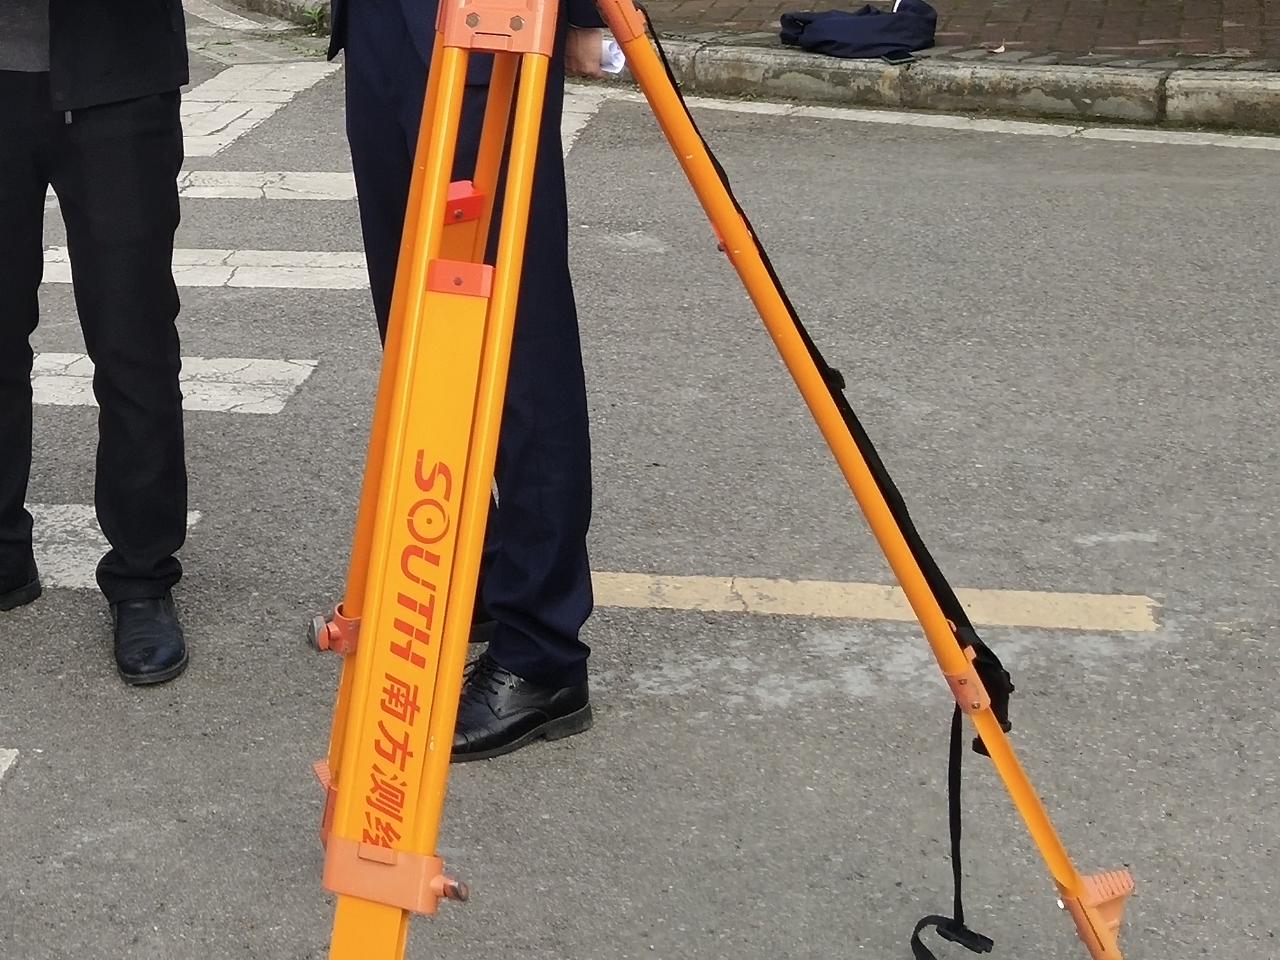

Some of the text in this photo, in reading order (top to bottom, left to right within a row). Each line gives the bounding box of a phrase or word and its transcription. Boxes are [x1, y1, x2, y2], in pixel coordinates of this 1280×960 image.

[361, 448, 453, 850] SOUTH 南方测绘
